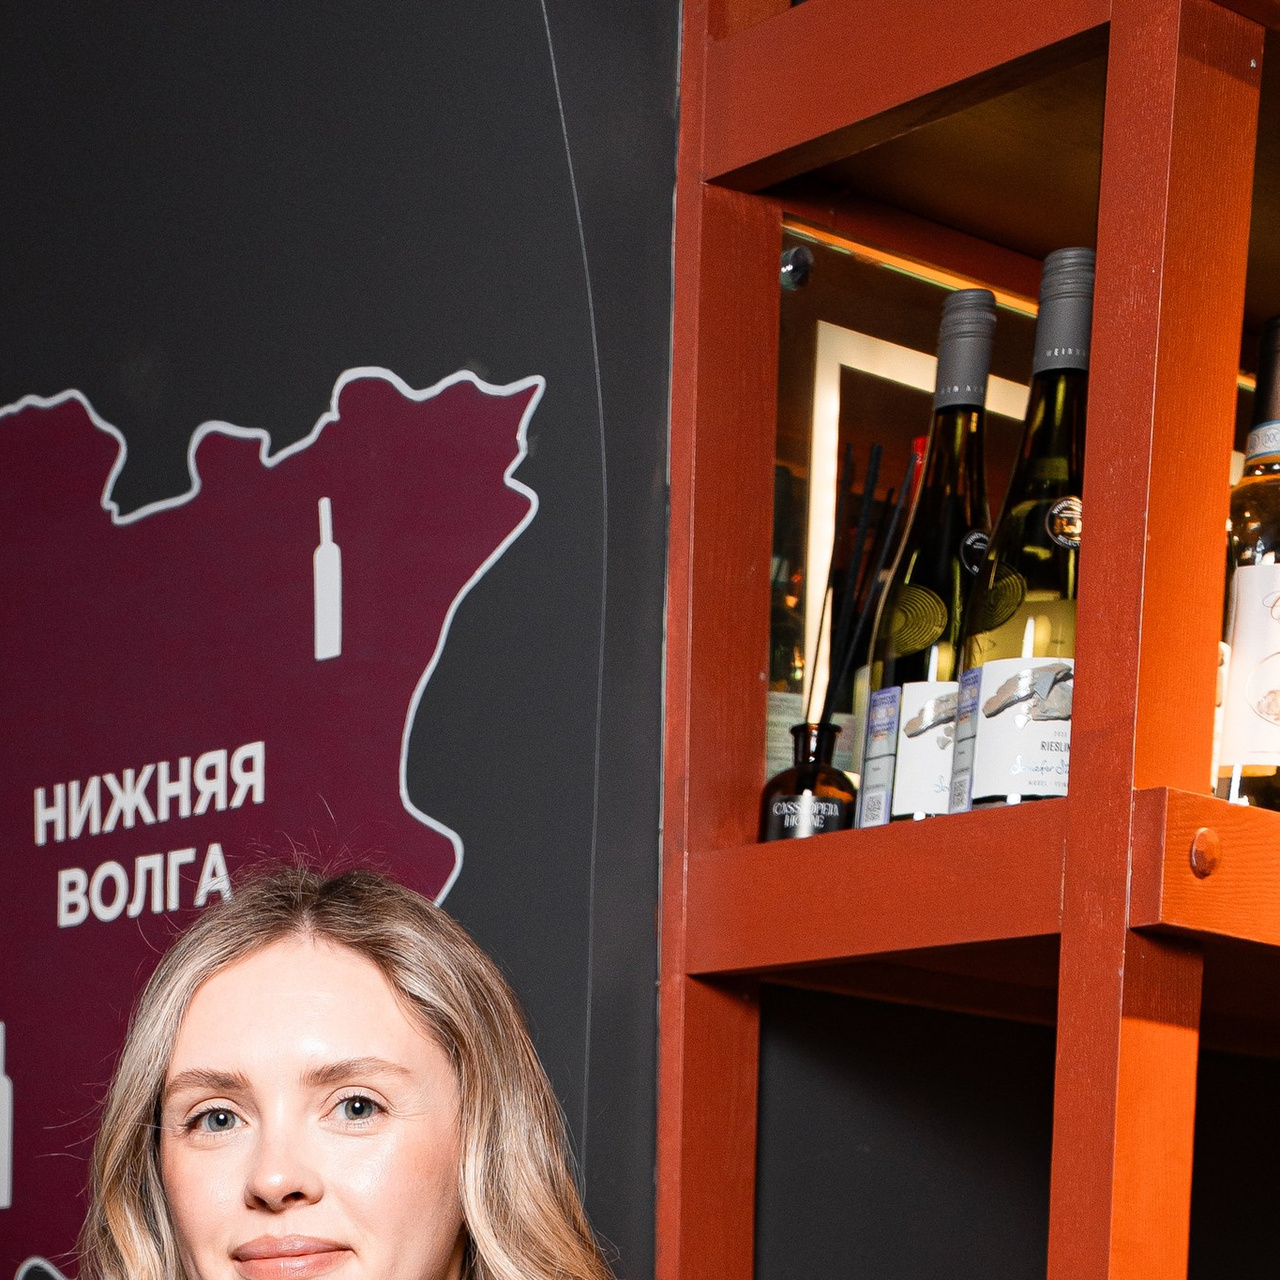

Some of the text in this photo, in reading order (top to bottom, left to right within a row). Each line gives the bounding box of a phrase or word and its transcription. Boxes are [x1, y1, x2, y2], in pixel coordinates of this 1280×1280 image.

[33, 741, 266, 846] НИЖНЯЯ
[772, 802, 839, 817] CASSOPEIA
[57, 843, 235, 929] ВОЛГА
